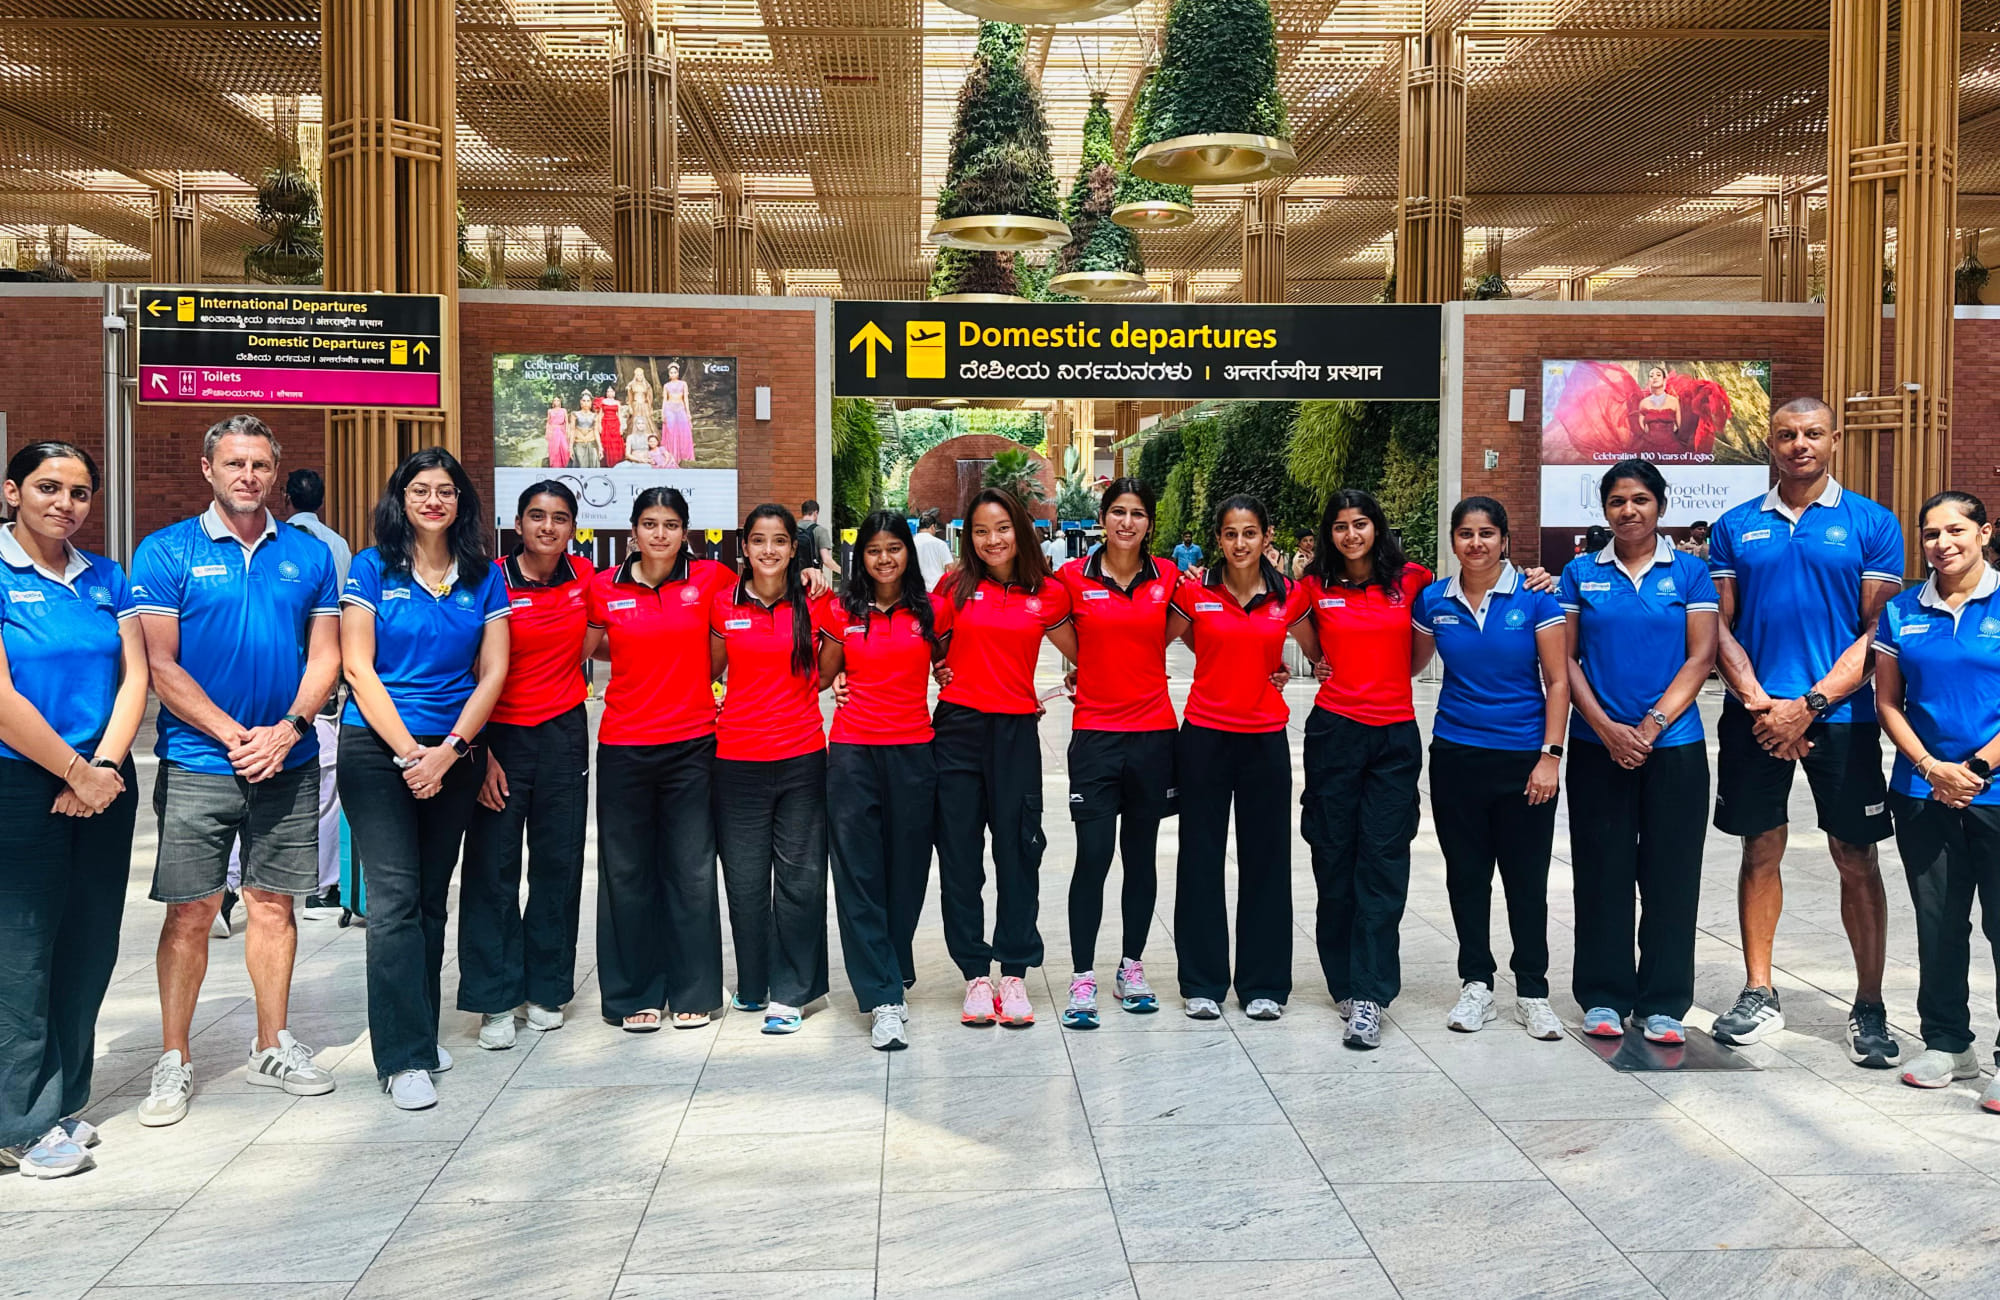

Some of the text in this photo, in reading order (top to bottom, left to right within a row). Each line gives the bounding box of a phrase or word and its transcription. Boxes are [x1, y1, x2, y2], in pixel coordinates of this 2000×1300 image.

[200, 297, 368, 314] International Departures
[248, 335, 385, 352] Domestic Departures
[960, 321, 1277, 354] Domestic departures
[524, 359, 579, 373] Celebrating
[959, 359, 1193, 381] ದೇಶೀಯ ನಿರ್ಗಮನಗಳು
[1326, 364, 1384, 382] प्रस्थान
[202, 371, 242, 383] Toilets
[574, 371, 586, 380] of
[586, 371, 618, 383] Legacy
[1640, 452, 1655, 460] 100
[1656, 452, 1679, 461] Years
[1680, 451, 1689, 461] of
[1689, 452, 1715, 463] Legacy
[1666, 482, 1730, 498] Together
[1671, 496, 1727, 509] Purever
